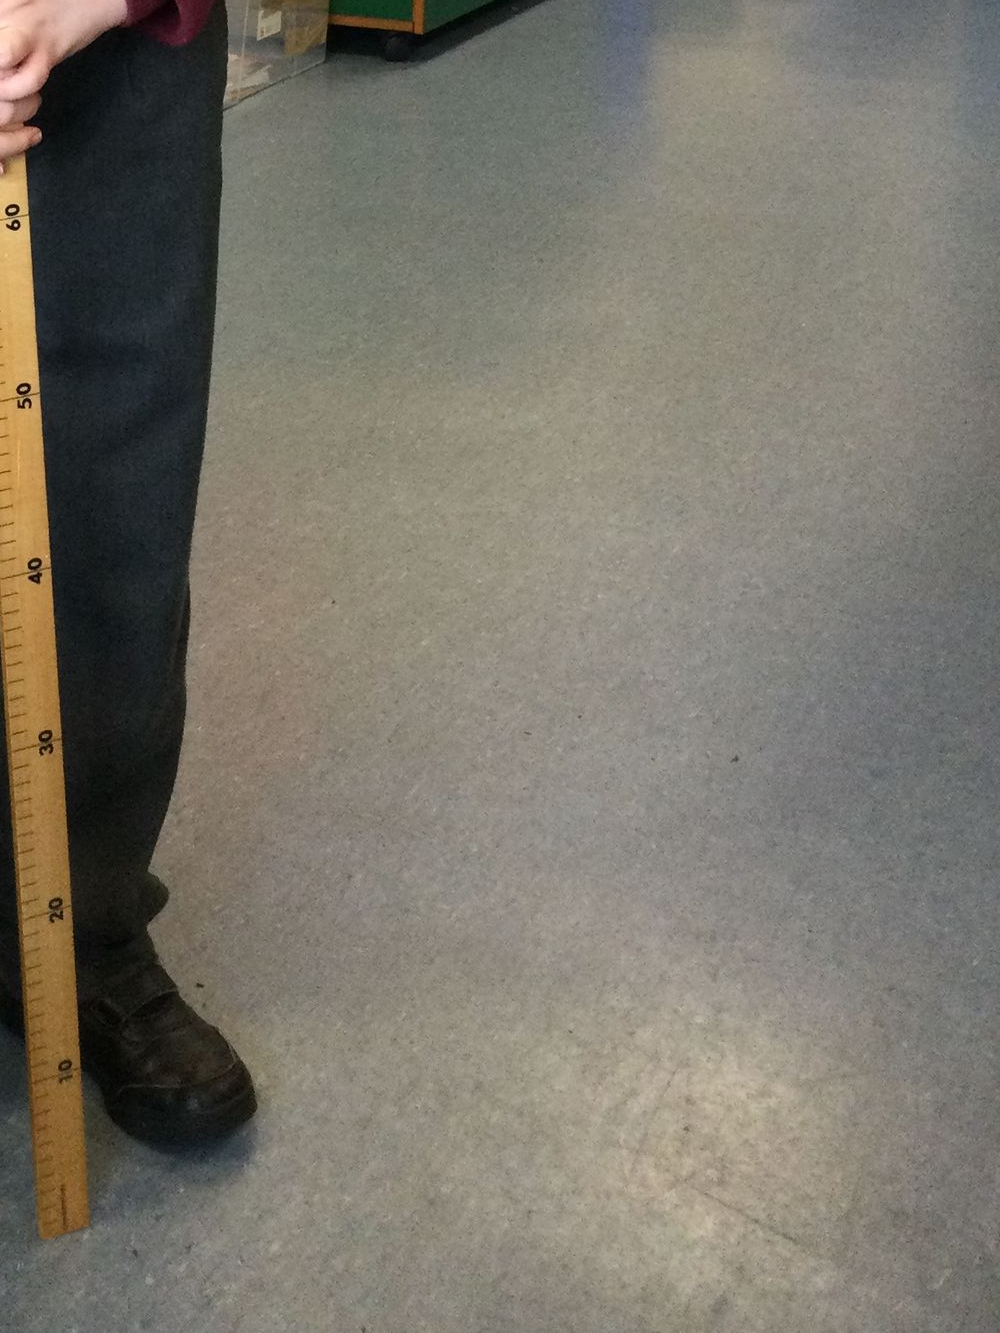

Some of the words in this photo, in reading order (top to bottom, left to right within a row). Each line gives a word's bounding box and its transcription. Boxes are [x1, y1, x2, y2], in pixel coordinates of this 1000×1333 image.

[4, 203, 21, 232] 60
[16, 382, 32, 410] 50
[27, 557, 43, 585] 40
[39, 729, 54, 757] 30
[48, 897, 64, 924] 20
[58, 1059, 73, 1084] 10
